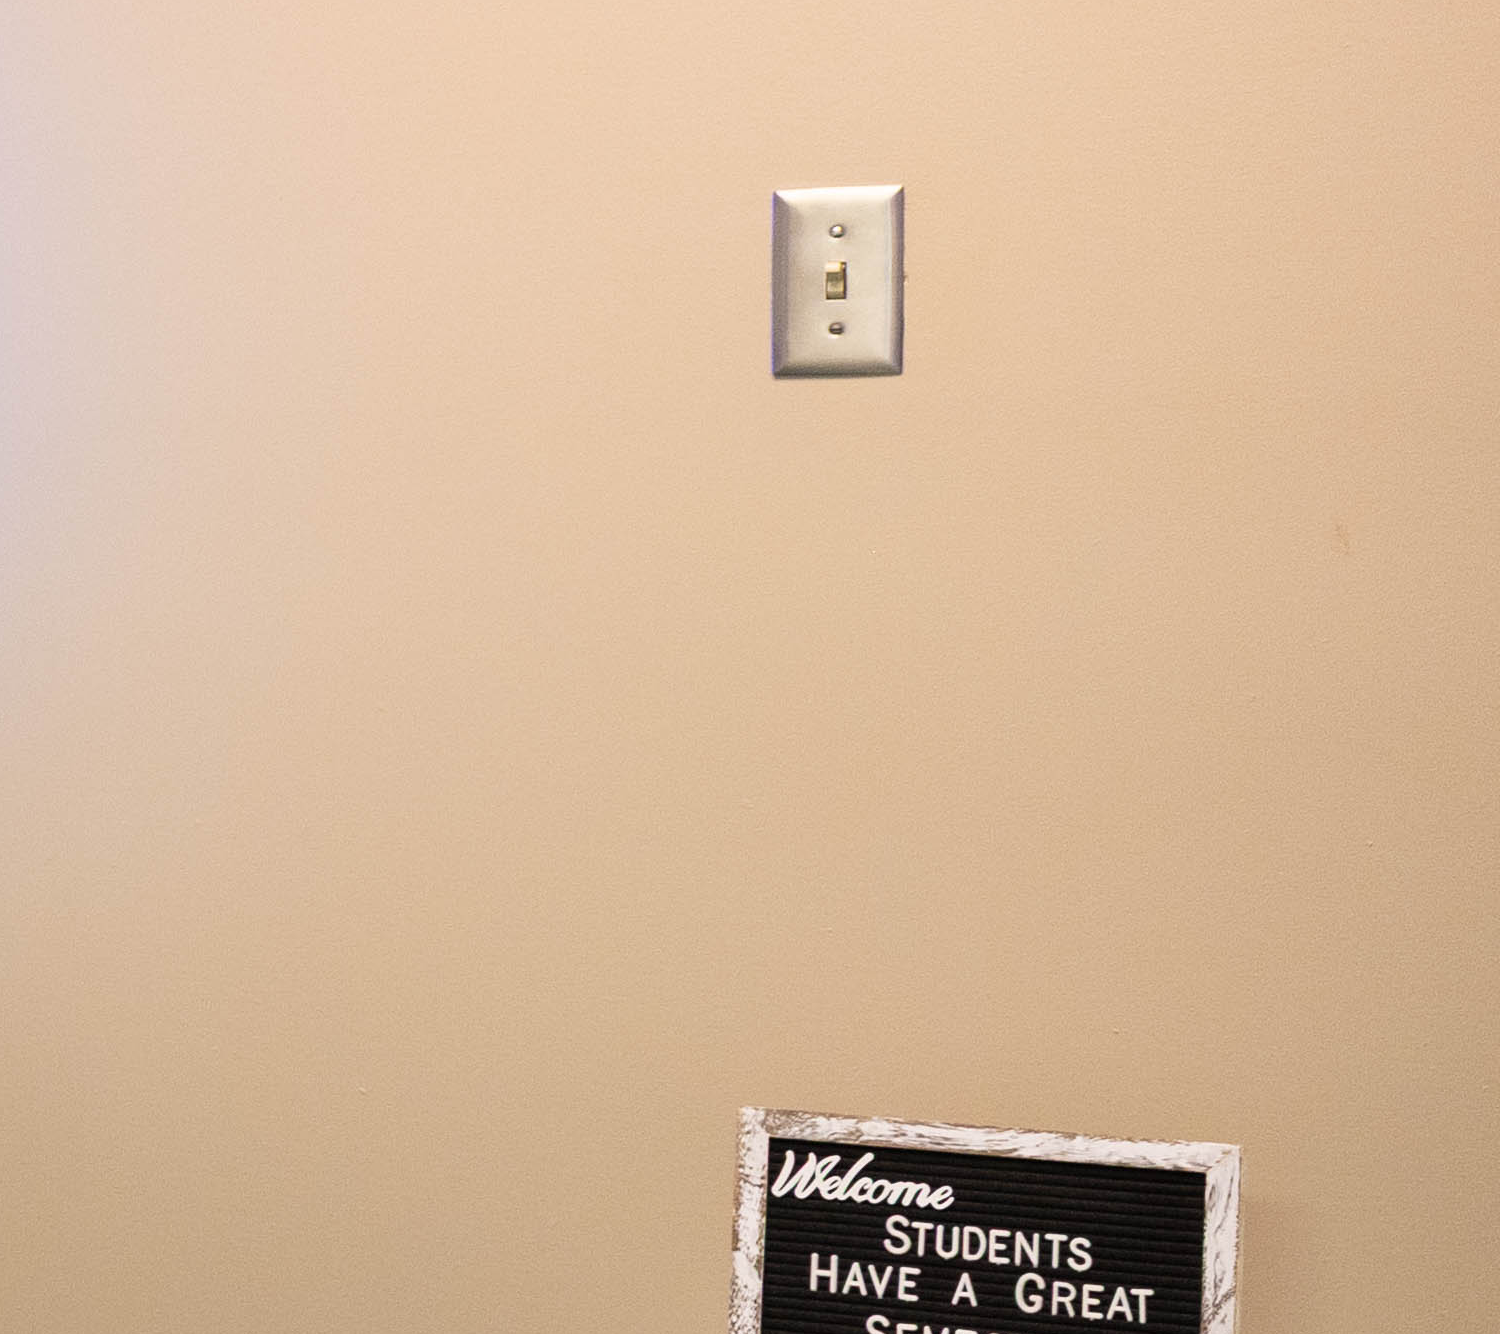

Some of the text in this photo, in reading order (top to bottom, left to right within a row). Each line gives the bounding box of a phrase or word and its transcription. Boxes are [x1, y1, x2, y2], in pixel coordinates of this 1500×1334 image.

[771, 1150, 954, 1210] Welcome
[884, 1215, 1093, 1272] STUDENTS
[809, 1253, 1154, 1324] HAVE A GREAT
